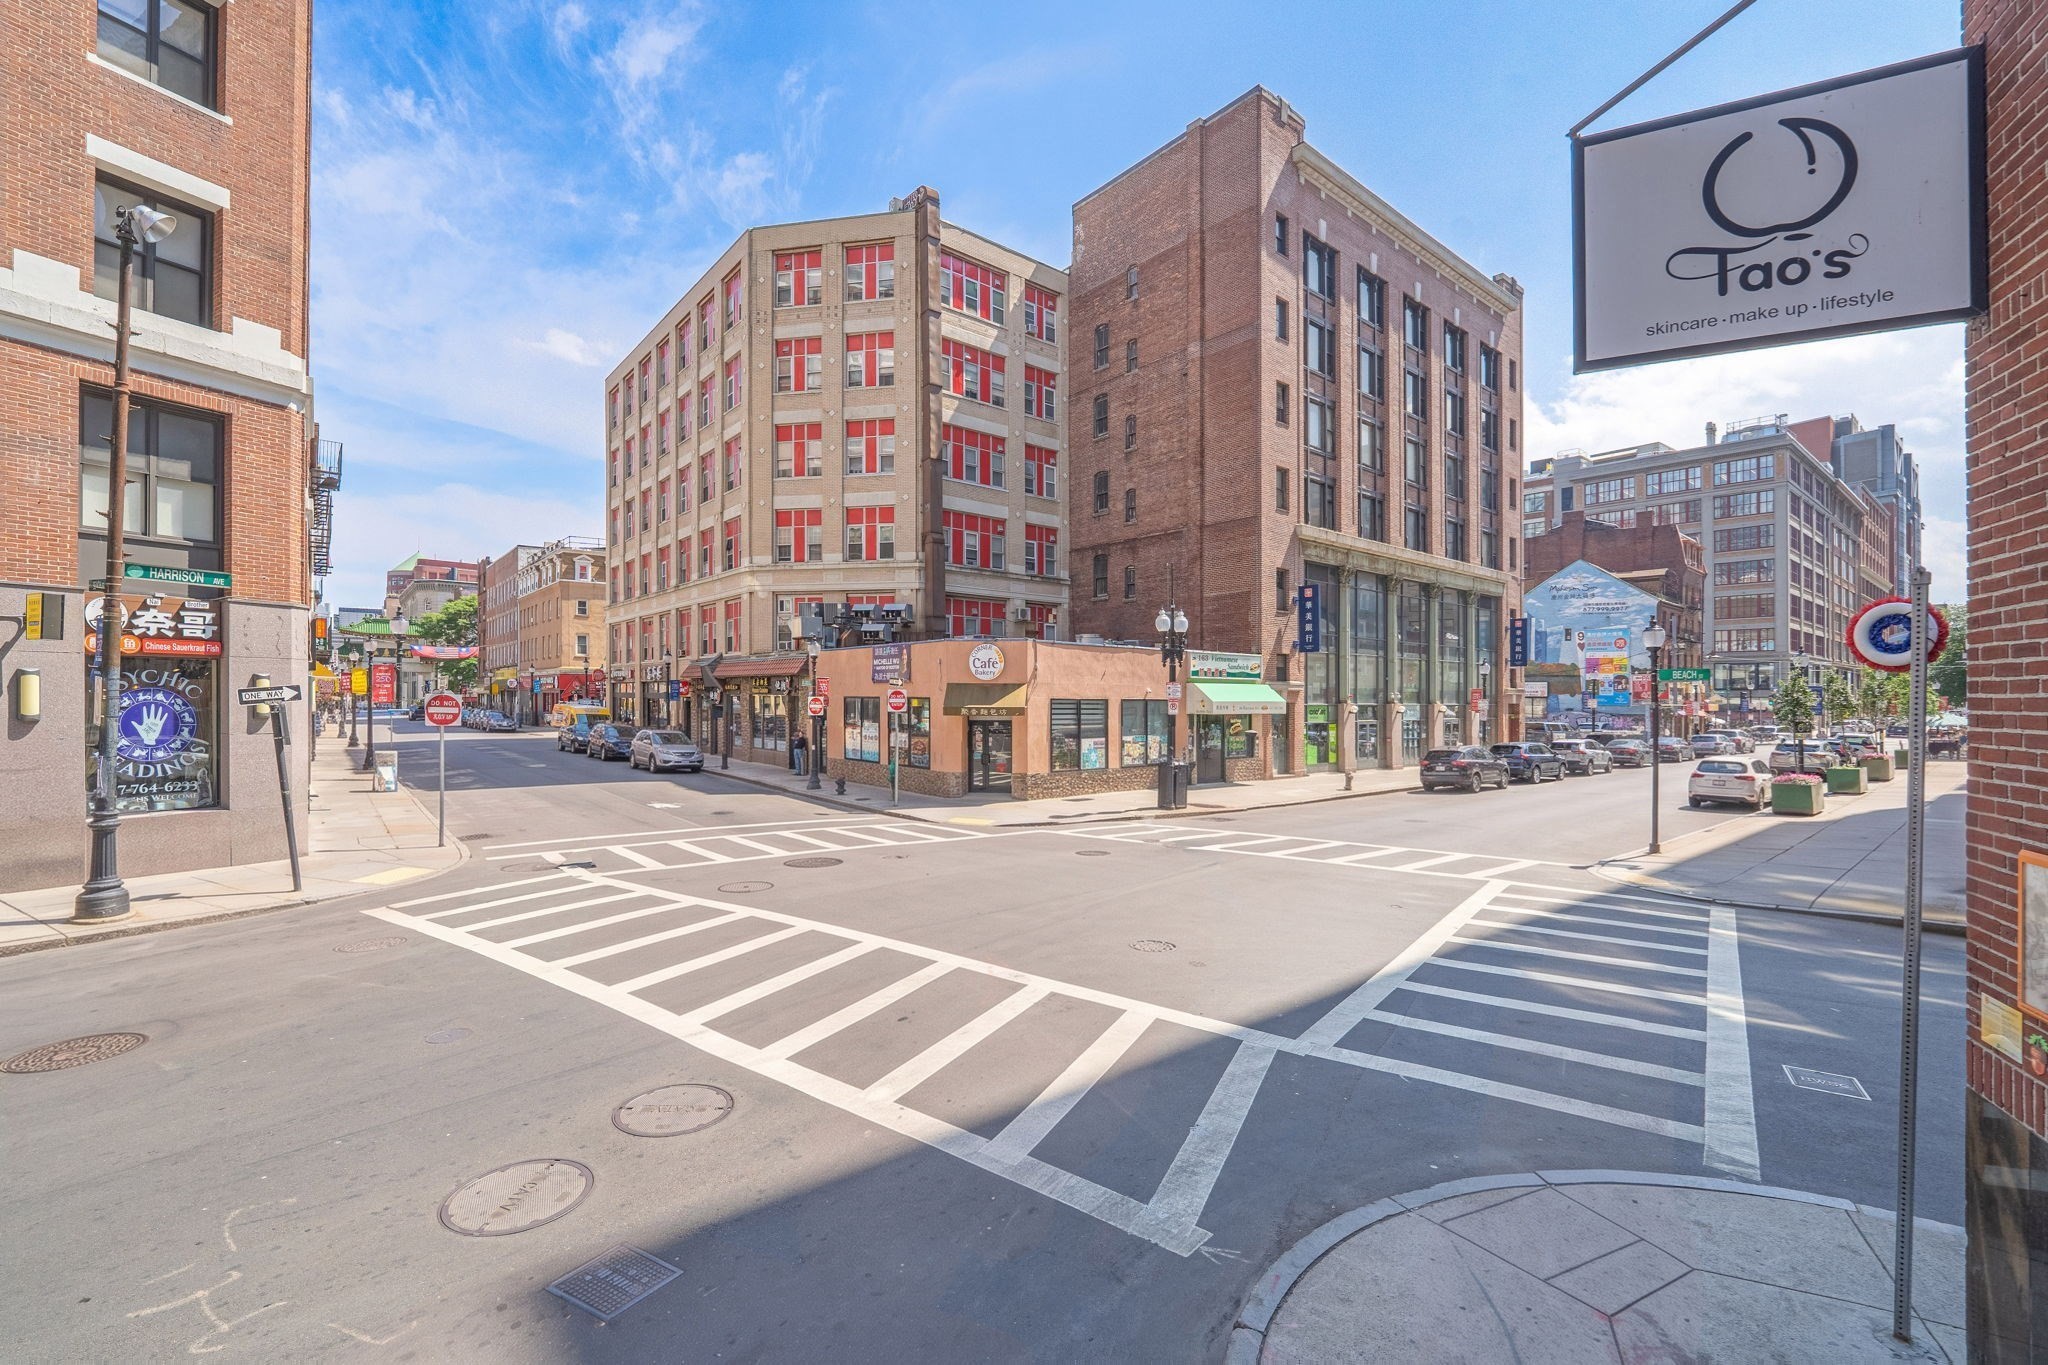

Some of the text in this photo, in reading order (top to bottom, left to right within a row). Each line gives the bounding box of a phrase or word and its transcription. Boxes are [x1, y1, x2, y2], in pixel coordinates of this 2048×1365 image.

[1665, 233, 1869, 297] Tao's
[1645, 289, 1895, 337] skincare make up lifestyle
[149, 567, 225, 586] HARRISON AVE
[187, 601, 209, 609] Brother
[131, 608, 218, 640] 奈哥
[145, 641, 220, 653] Chinese Sauerkraut Fish
[972, 657, 999, 669] Café
[974, 669, 996, 677] Bakery
[1672, 671, 1697, 679] BEACH
[266, 690, 283, 698] WAY
